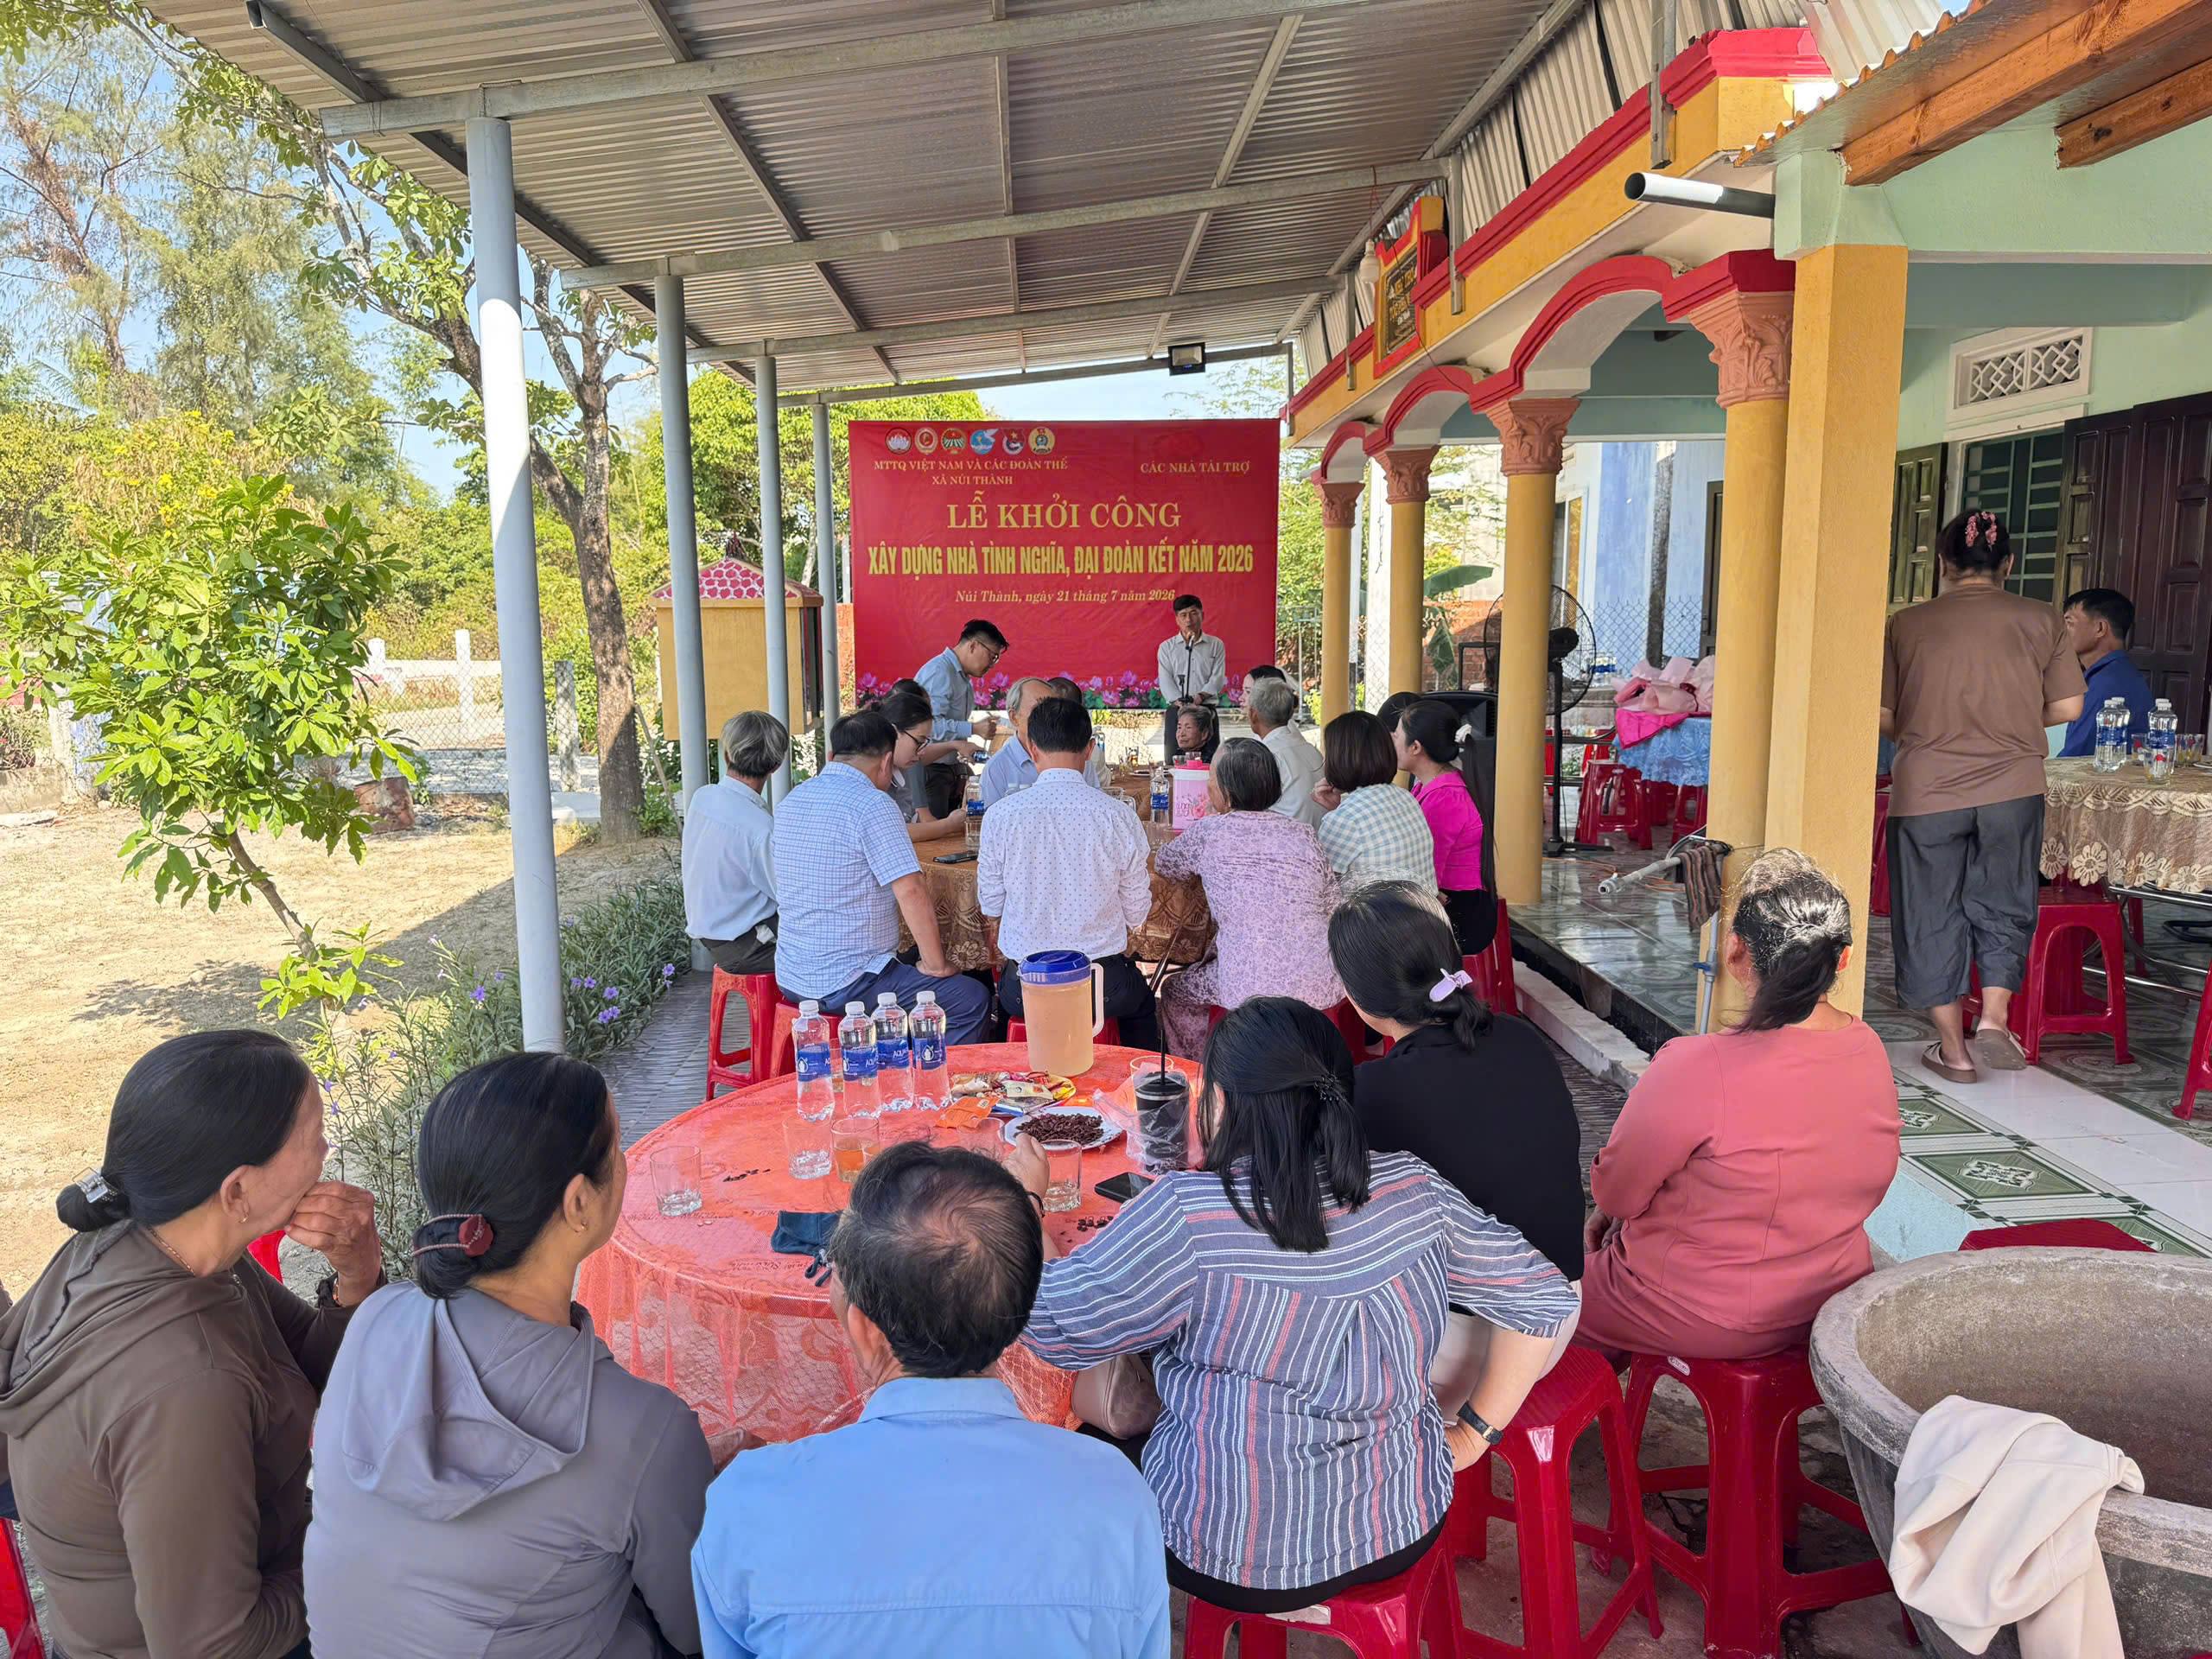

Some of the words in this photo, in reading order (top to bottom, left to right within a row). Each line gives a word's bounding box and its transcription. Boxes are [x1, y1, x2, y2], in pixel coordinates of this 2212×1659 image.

[874, 460, 906, 471] MTTQ
[909, 458, 936, 472] VIỆT
[938, 460, 963, 470] NAM
[966, 458, 982, 470] VÀ
[984, 458, 1007, 470] CÁC
[1009, 457, 1042, 470] ĐOÀN
[1140, 461, 1166, 474] CÁC
[1169, 460, 1196, 473] NHÀ
[1223, 460, 1250, 474] TRỢ
[950, 474, 970, 485] NÚI
[973, 473, 1014, 485] THÀNH
[947, 490, 988, 529] LỄ
[997, 493, 1080, 528] KHỞI
[1090, 494, 1182, 528] CÔNG
[868, 541, 897, 575] XÂY
[901, 543, 944, 581] DỰNG
[946, 541, 978, 575] NHÀ
[982, 541, 1016, 575] TÌNH
[1020, 541, 1071, 578] NGHĨA,
[1074, 545, 1099, 580] ĐẠI
[1103, 539, 1144, 574] ĐOÀN
[1147, 537, 1175, 574] KẾT
[1179, 539, 1214, 573] NĂM
[1217, 544, 1254, 573] 2026
[955, 590, 977, 602] Núi
[981, 590, 1022, 604] Thành,
[1025, 589, 1054, 604] ngày
[1056, 590, 1070, 602] 21
[1072, 589, 1109, 604] tháng
[1110, 589, 1118, 602] 7
[1120, 589, 1146, 601] năm
[1147, 588, 1176, 601] 2026
